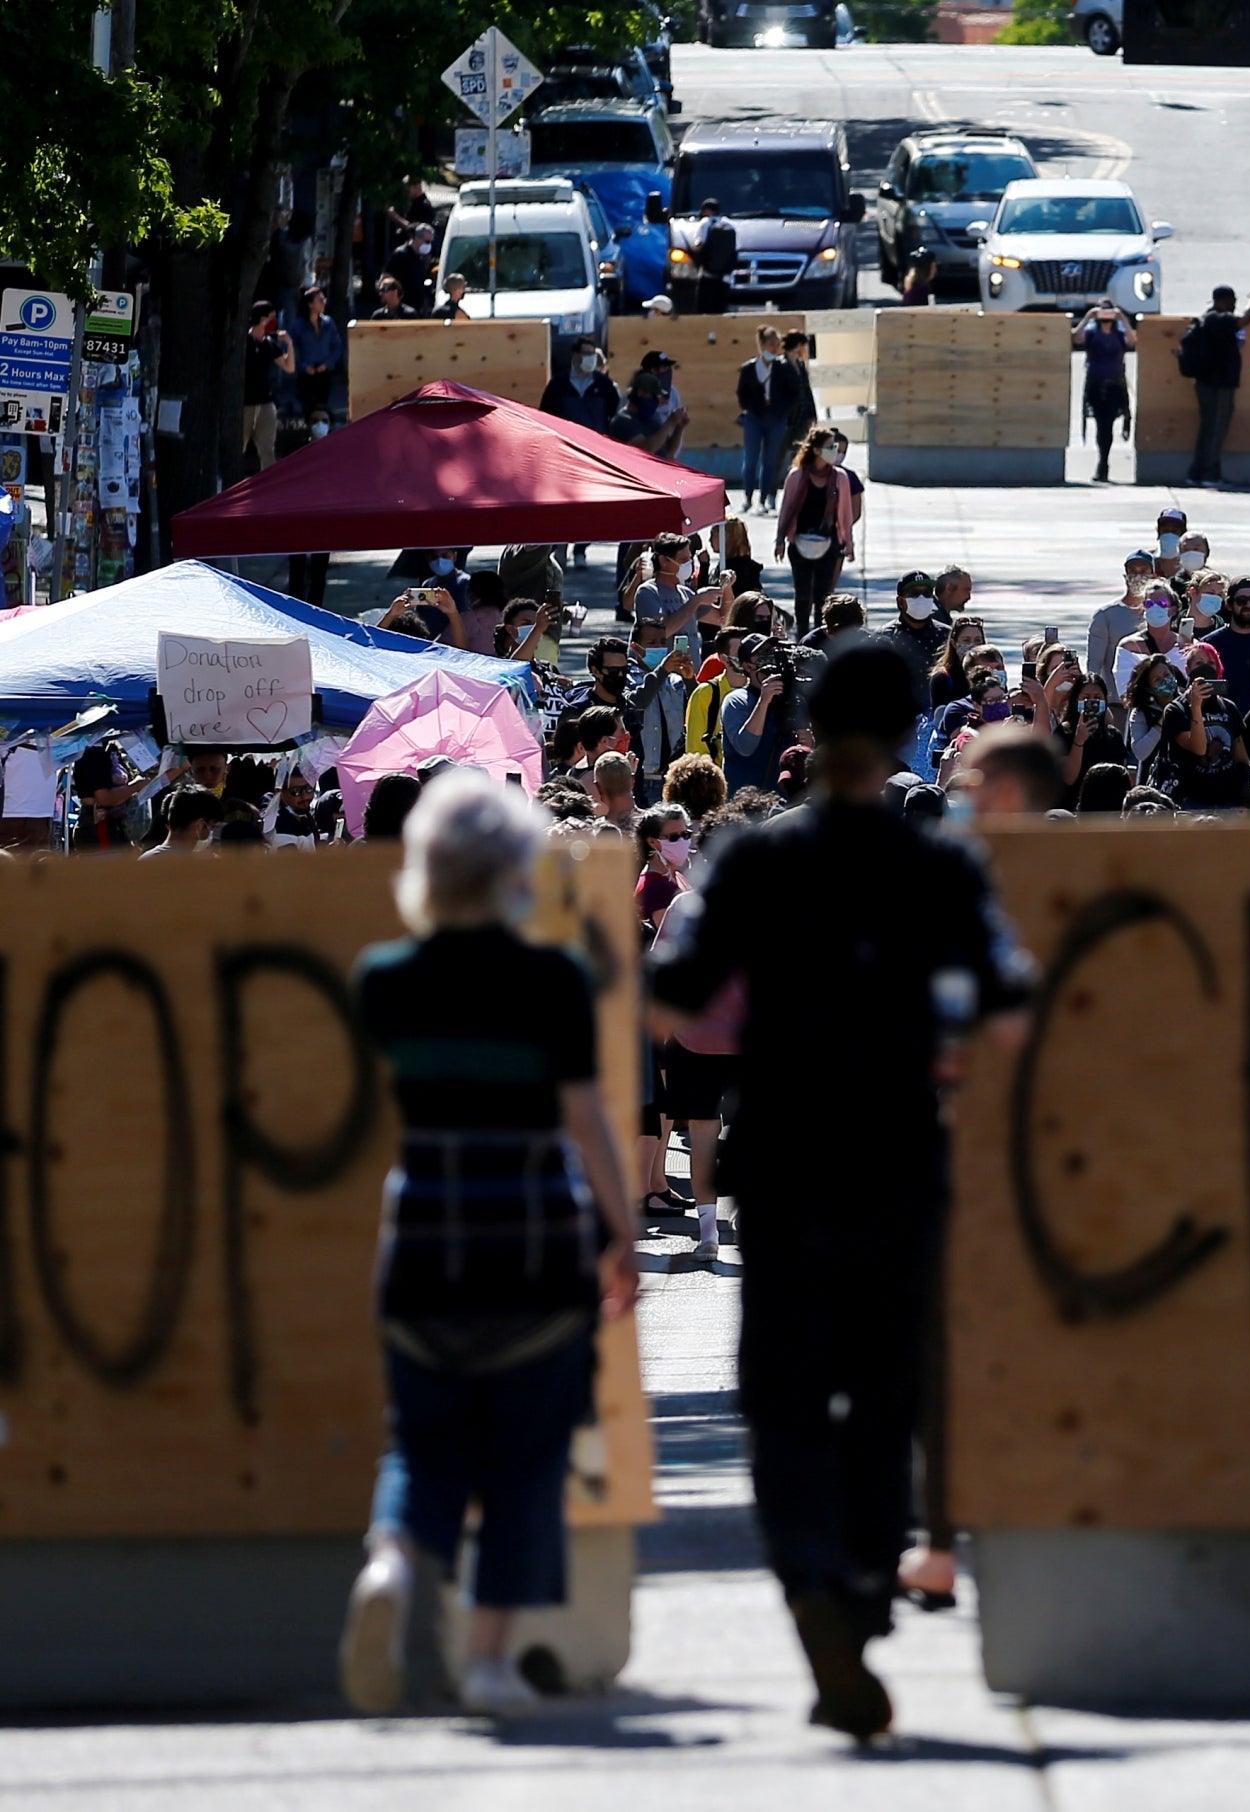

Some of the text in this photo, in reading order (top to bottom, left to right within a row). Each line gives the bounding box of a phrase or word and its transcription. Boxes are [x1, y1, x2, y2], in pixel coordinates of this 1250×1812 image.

[462, 79, 485, 93] SPD
[2, 336, 68, 351] Pay 8am-10pm
[86, 339, 126, 354] 87431
[0, 362, 65, 382] 2 Hours Max
[165, 640, 262, 673] Donation
[183, 677, 285, 716] drop off
[170, 712, 231, 741] here
